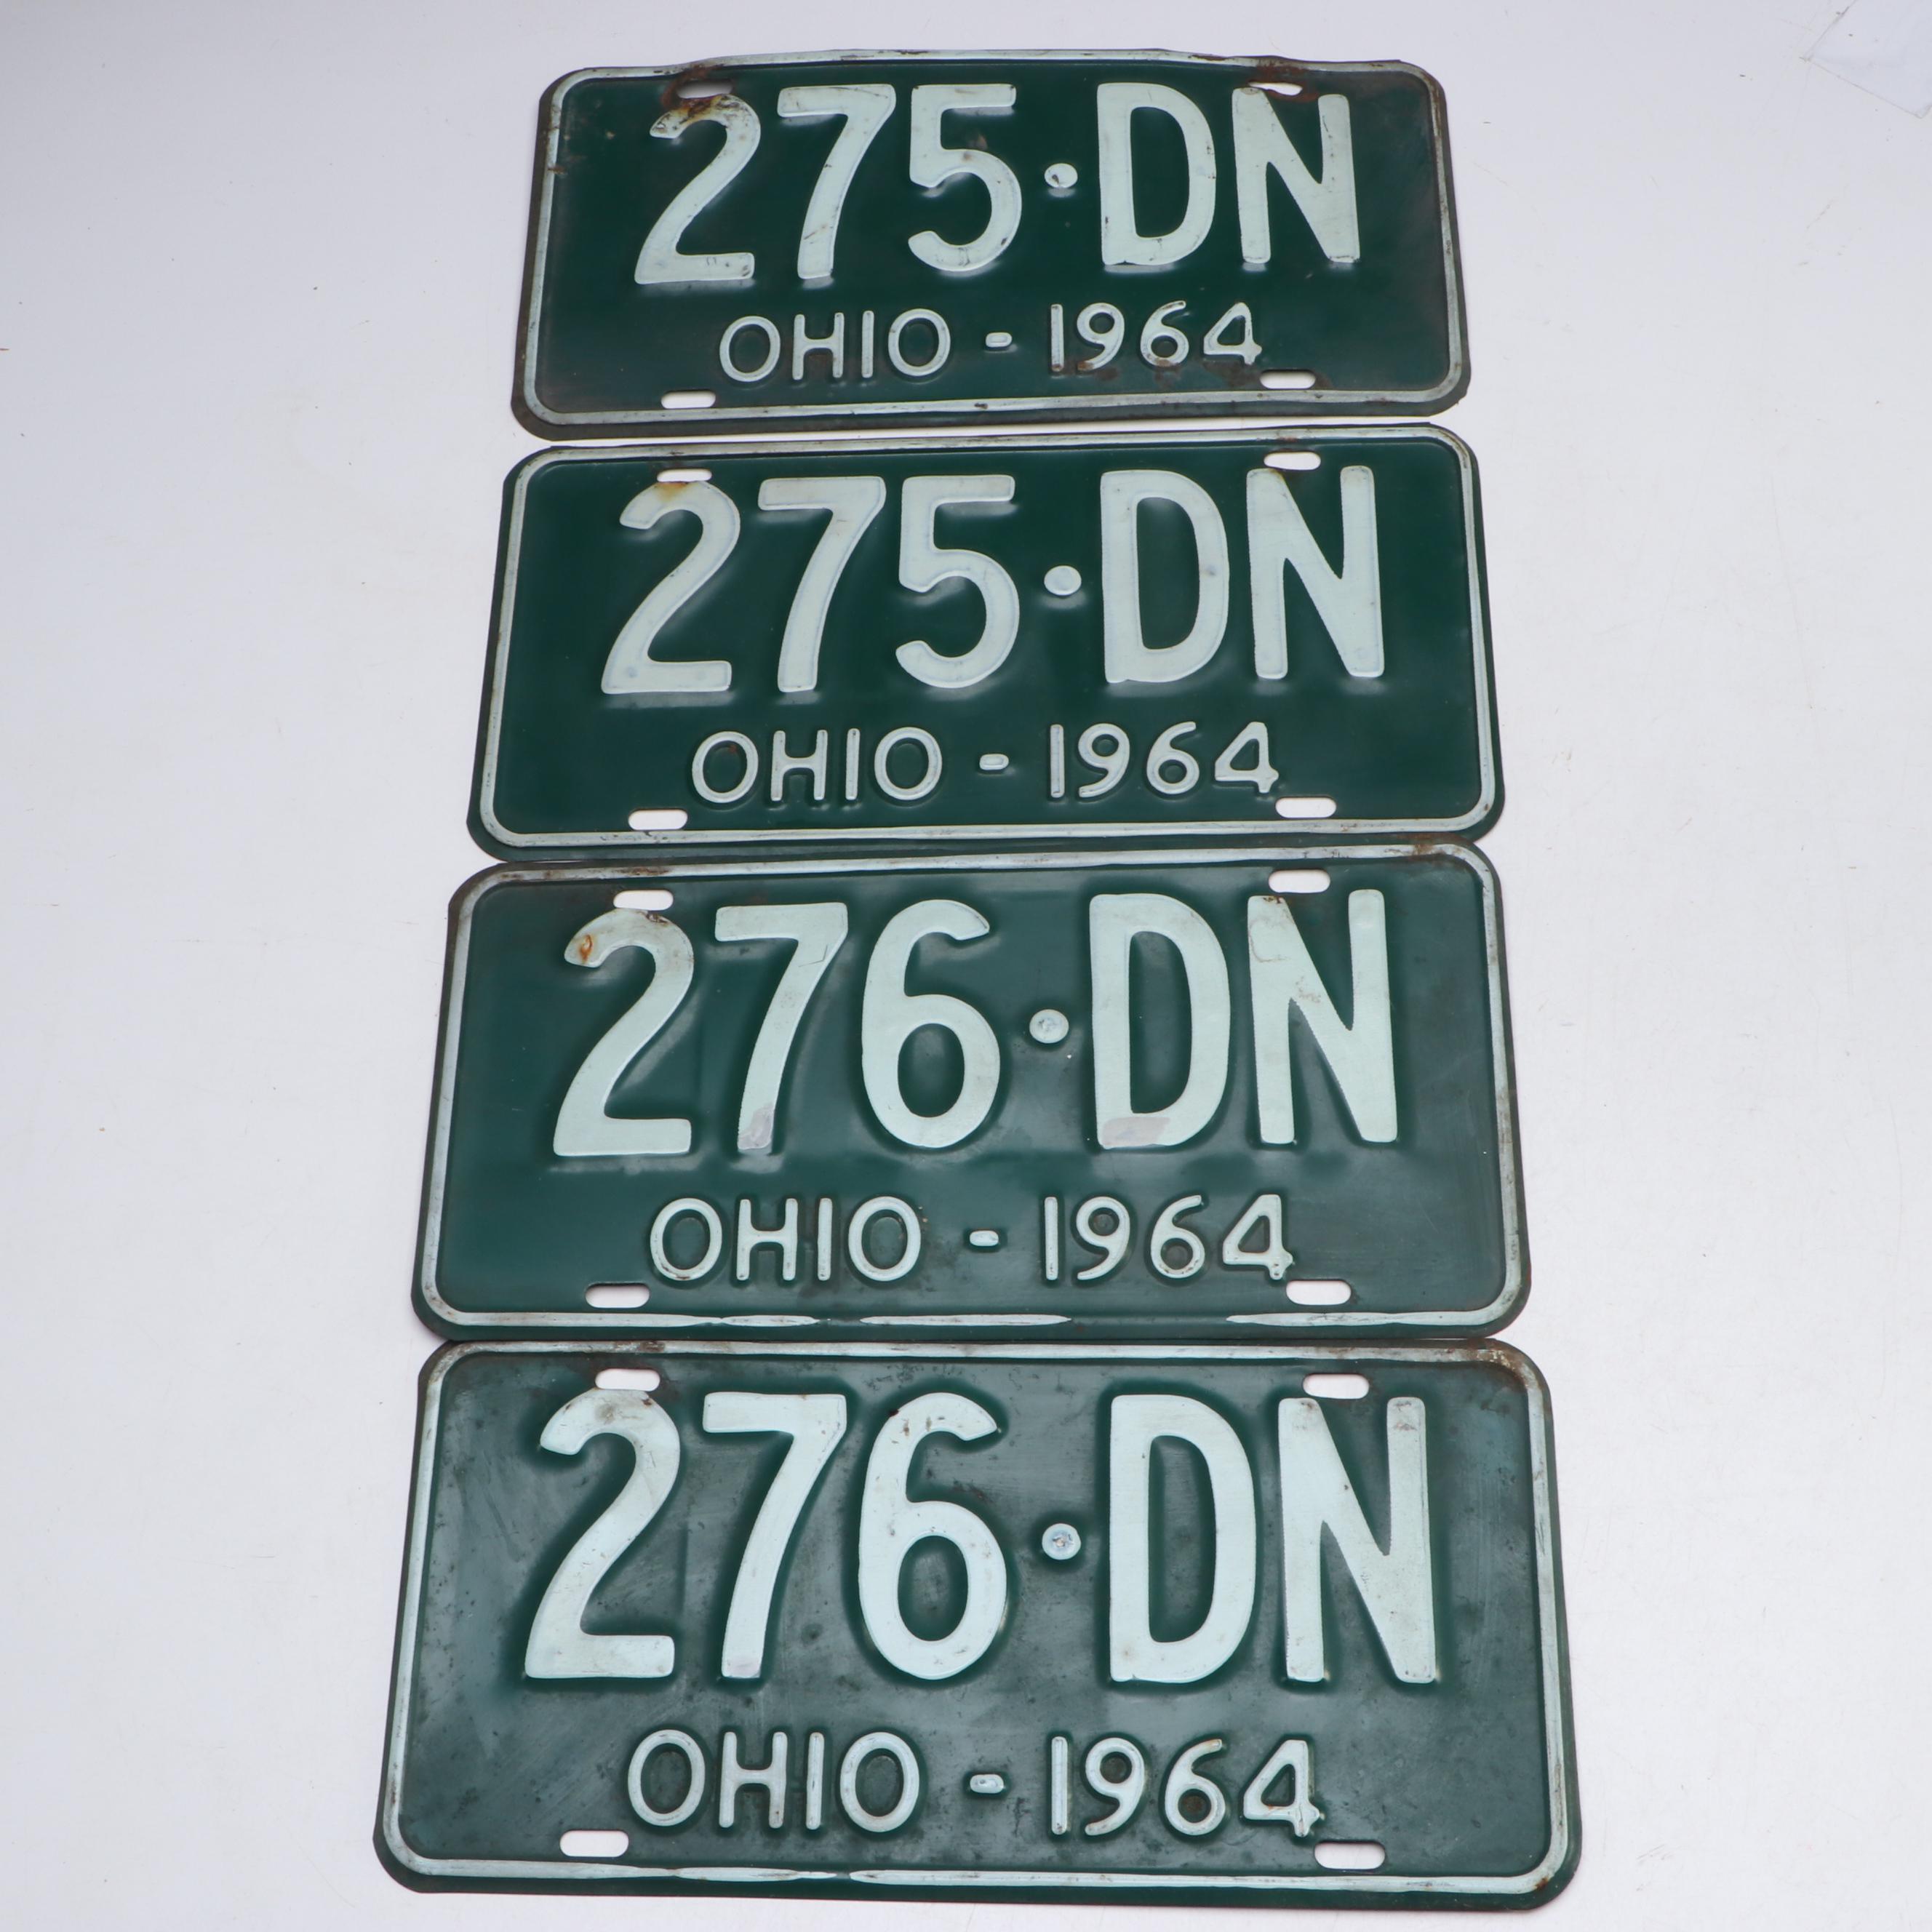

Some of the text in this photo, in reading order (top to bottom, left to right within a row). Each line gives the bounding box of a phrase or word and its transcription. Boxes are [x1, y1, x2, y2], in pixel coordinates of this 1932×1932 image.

[719, 308, 951, 383] OHIO
[1050, 300, 1263, 370] 1964
[691, 726, 943, 805] OHIO
[1050, 721, 1280, 799] 1964
[649, 1195, 923, 1282] OHIO
[1043, 1193, 1294, 1282] 1964
[627, 1728, 921, 1832] OHIO
[1050, 1736, 1326, 1837] 1964
